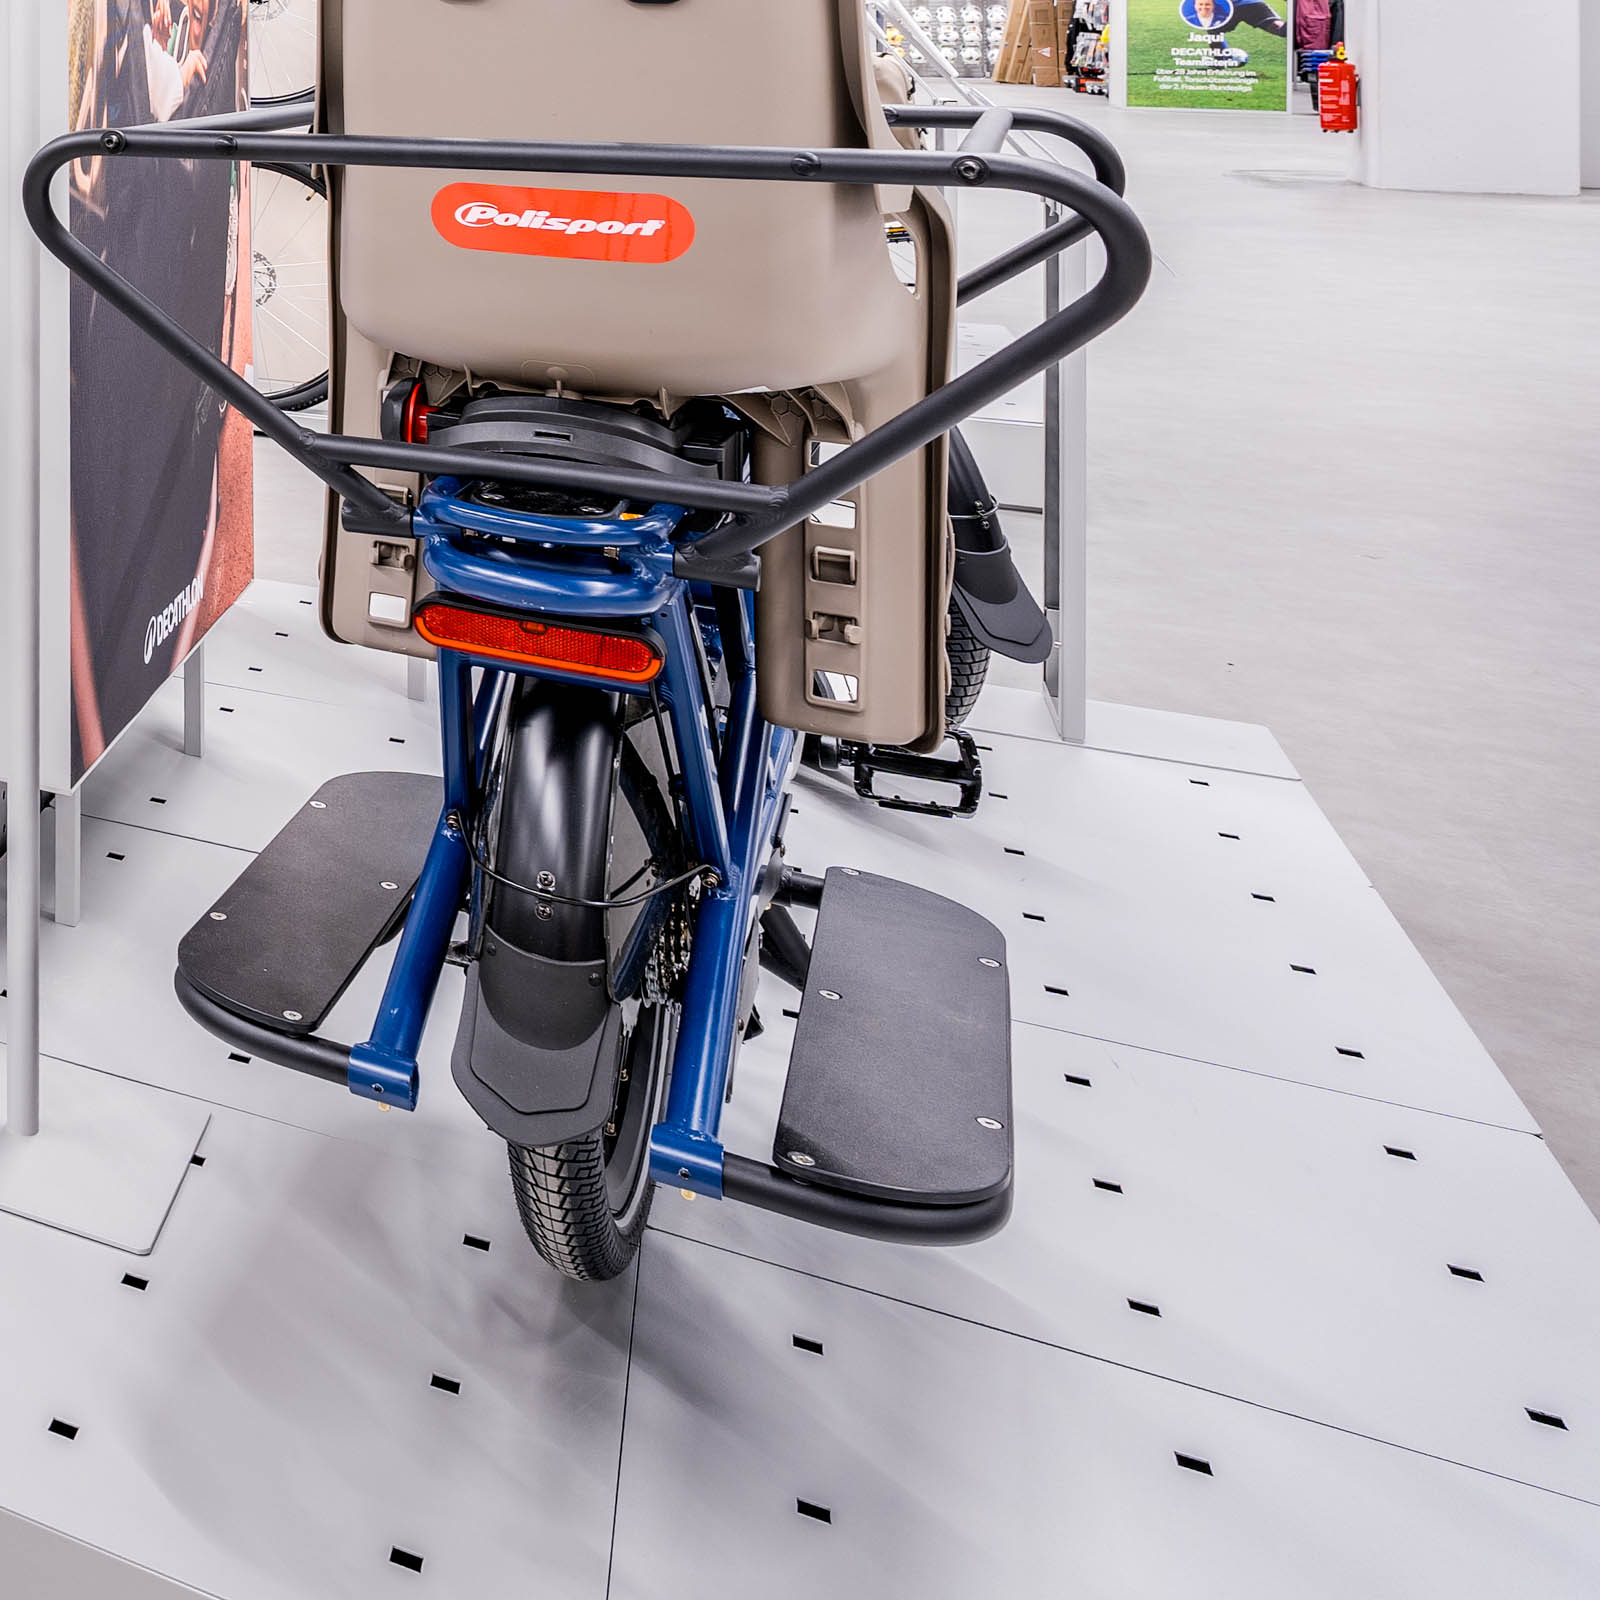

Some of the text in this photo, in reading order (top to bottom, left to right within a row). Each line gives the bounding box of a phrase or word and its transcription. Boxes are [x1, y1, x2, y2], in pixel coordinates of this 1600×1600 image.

[1188, 32, 1225, 44] Jaqui
[1170, 47, 1236, 56] DECATHLO
[455, 201, 666, 237] Polisport
[156, 572, 204, 647] DECATHLON
